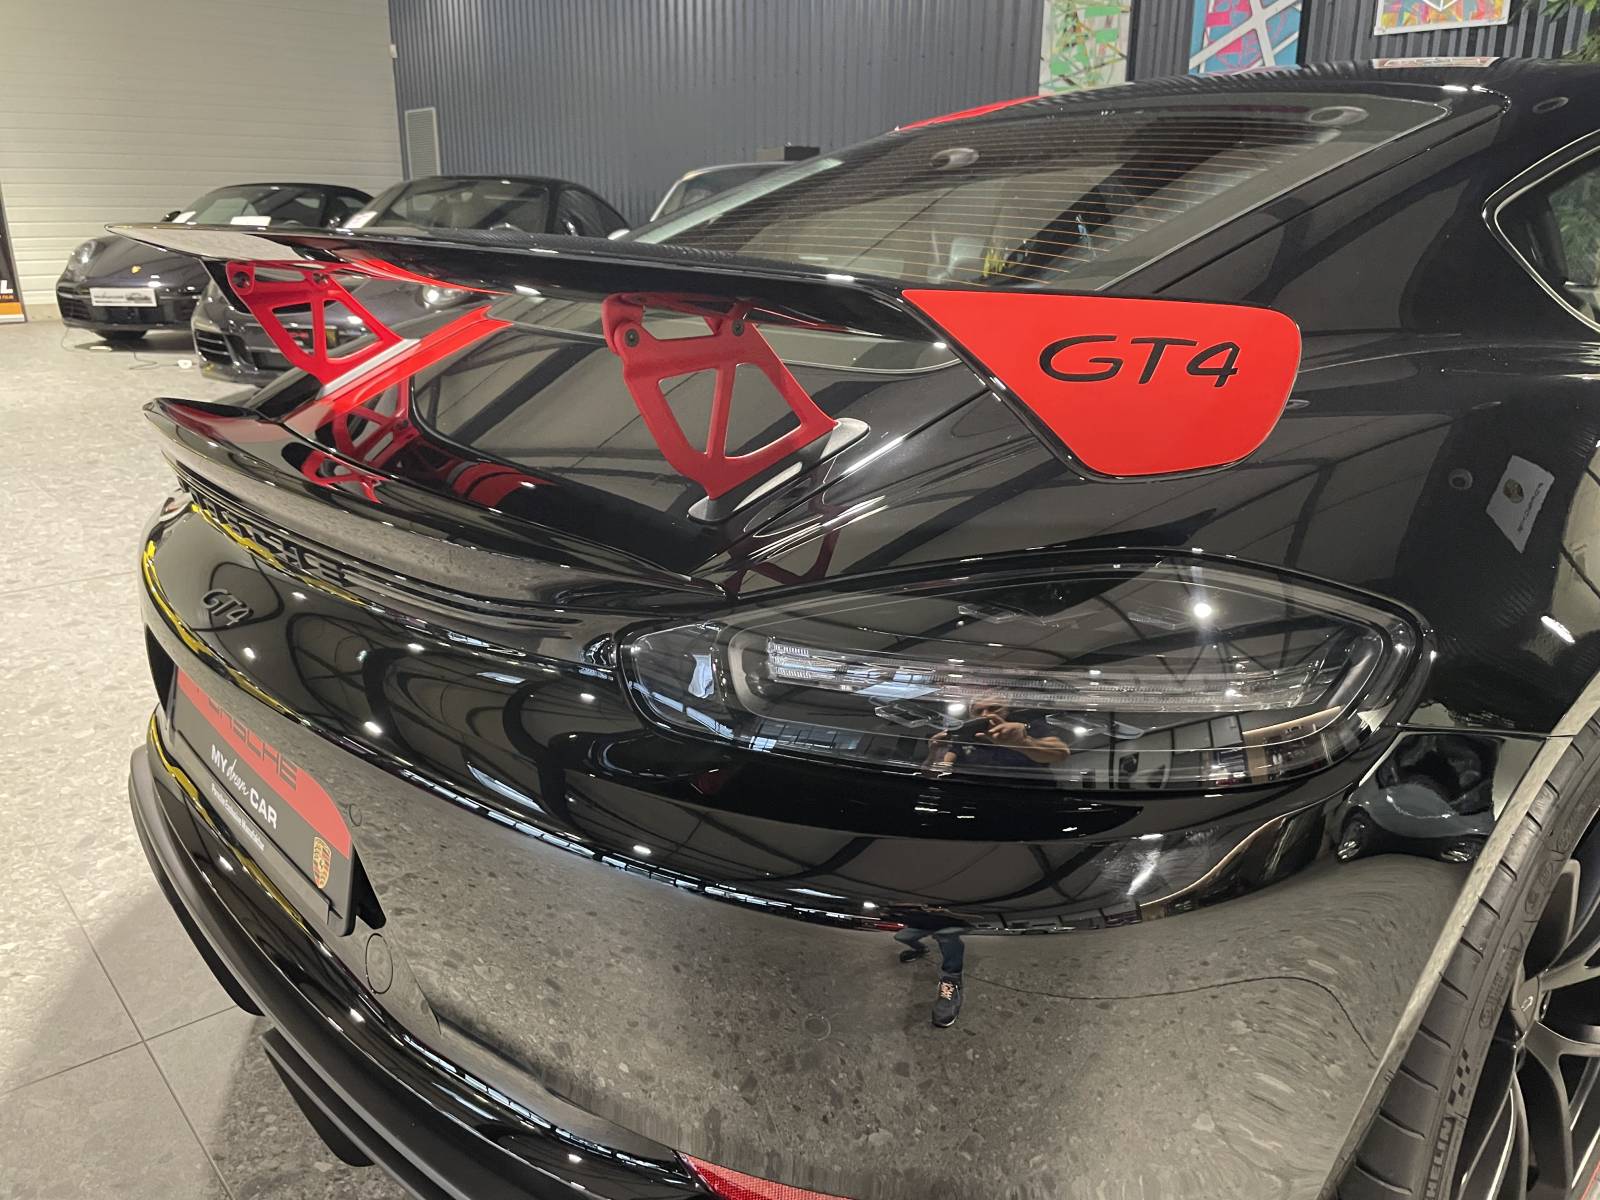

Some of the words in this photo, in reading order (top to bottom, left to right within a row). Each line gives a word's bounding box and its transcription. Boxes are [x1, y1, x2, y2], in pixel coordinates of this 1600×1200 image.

[1039, 335, 1241, 388] GT4
[201, 589, 249, 626] GT4
[211, 744, 227, 773] MY
[250, 787, 278, 830] CAR
[1424, 1119, 1453, 1200] HELIN
